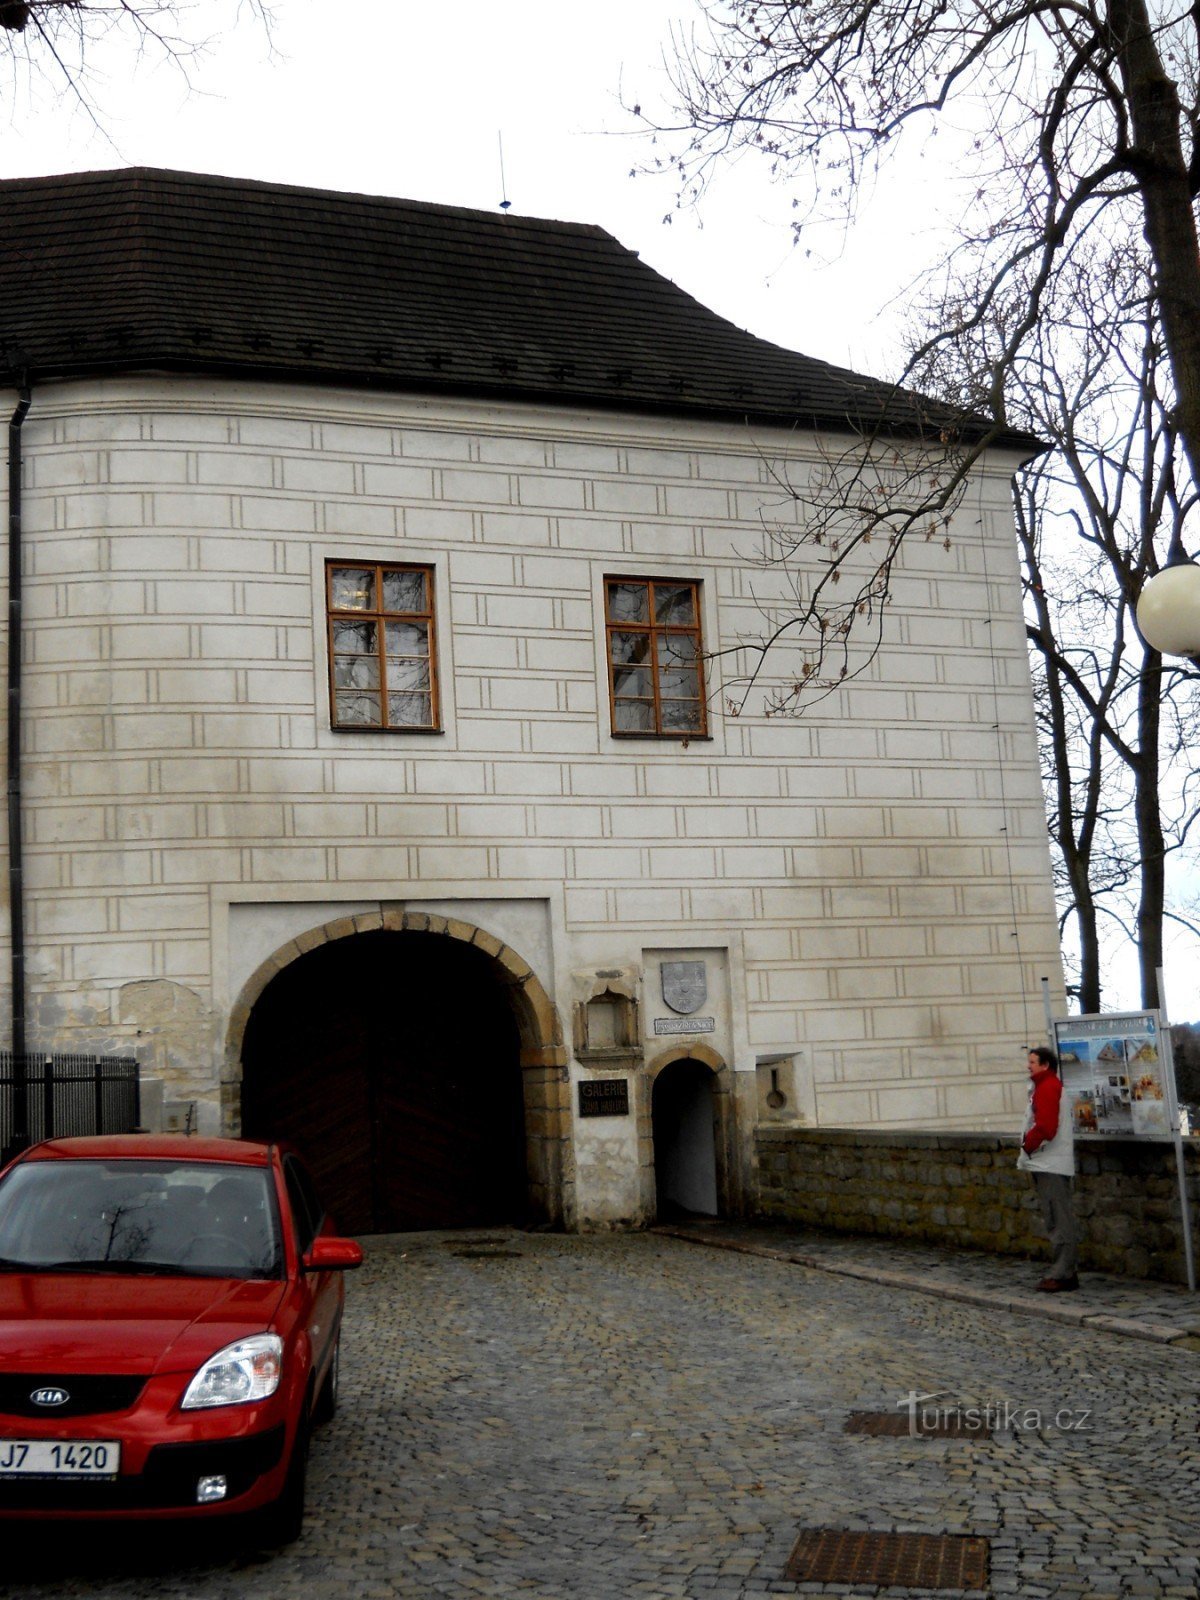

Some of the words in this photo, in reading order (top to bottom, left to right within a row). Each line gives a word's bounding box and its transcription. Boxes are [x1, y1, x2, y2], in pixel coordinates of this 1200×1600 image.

[582, 1082, 626, 1097] GALERIE
[37, 1391, 63, 1402] KIA
[51, 1445, 107, 1469] 1420
